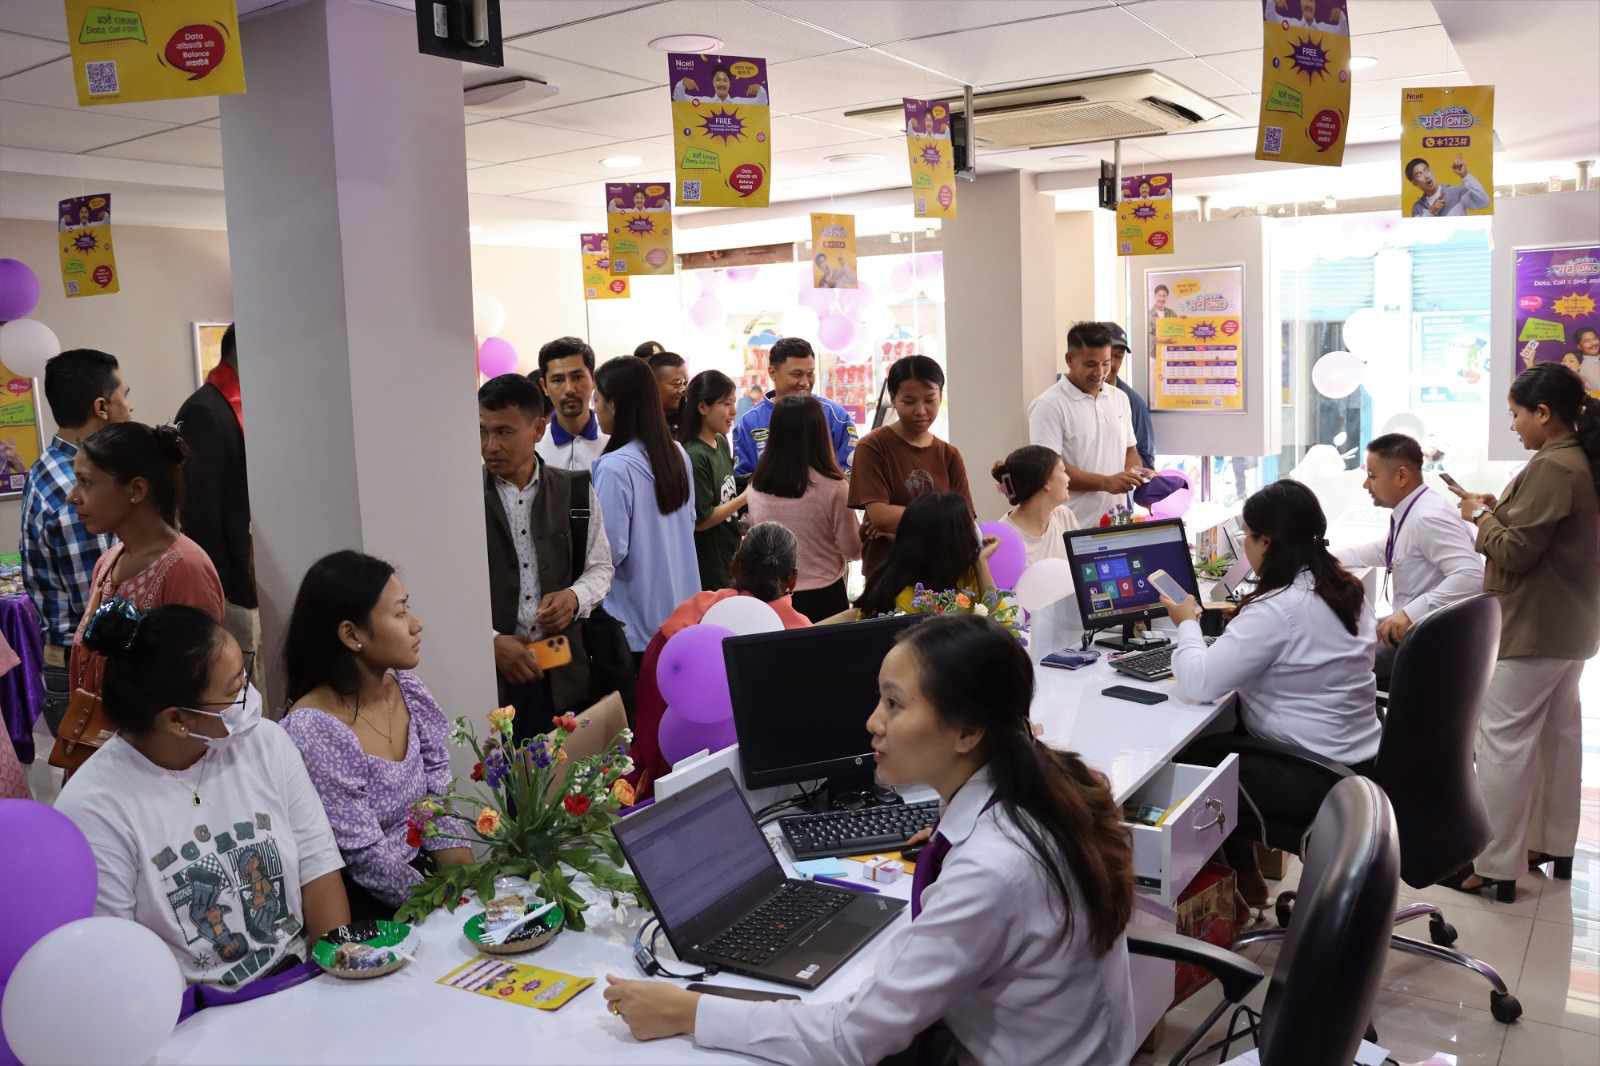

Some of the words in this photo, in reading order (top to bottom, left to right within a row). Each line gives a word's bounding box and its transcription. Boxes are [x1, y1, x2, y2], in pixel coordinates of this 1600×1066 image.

[185, 32, 203, 41] Data
[1302, 47, 1317, 56] FREE
[676, 59, 694, 67] Ncell
